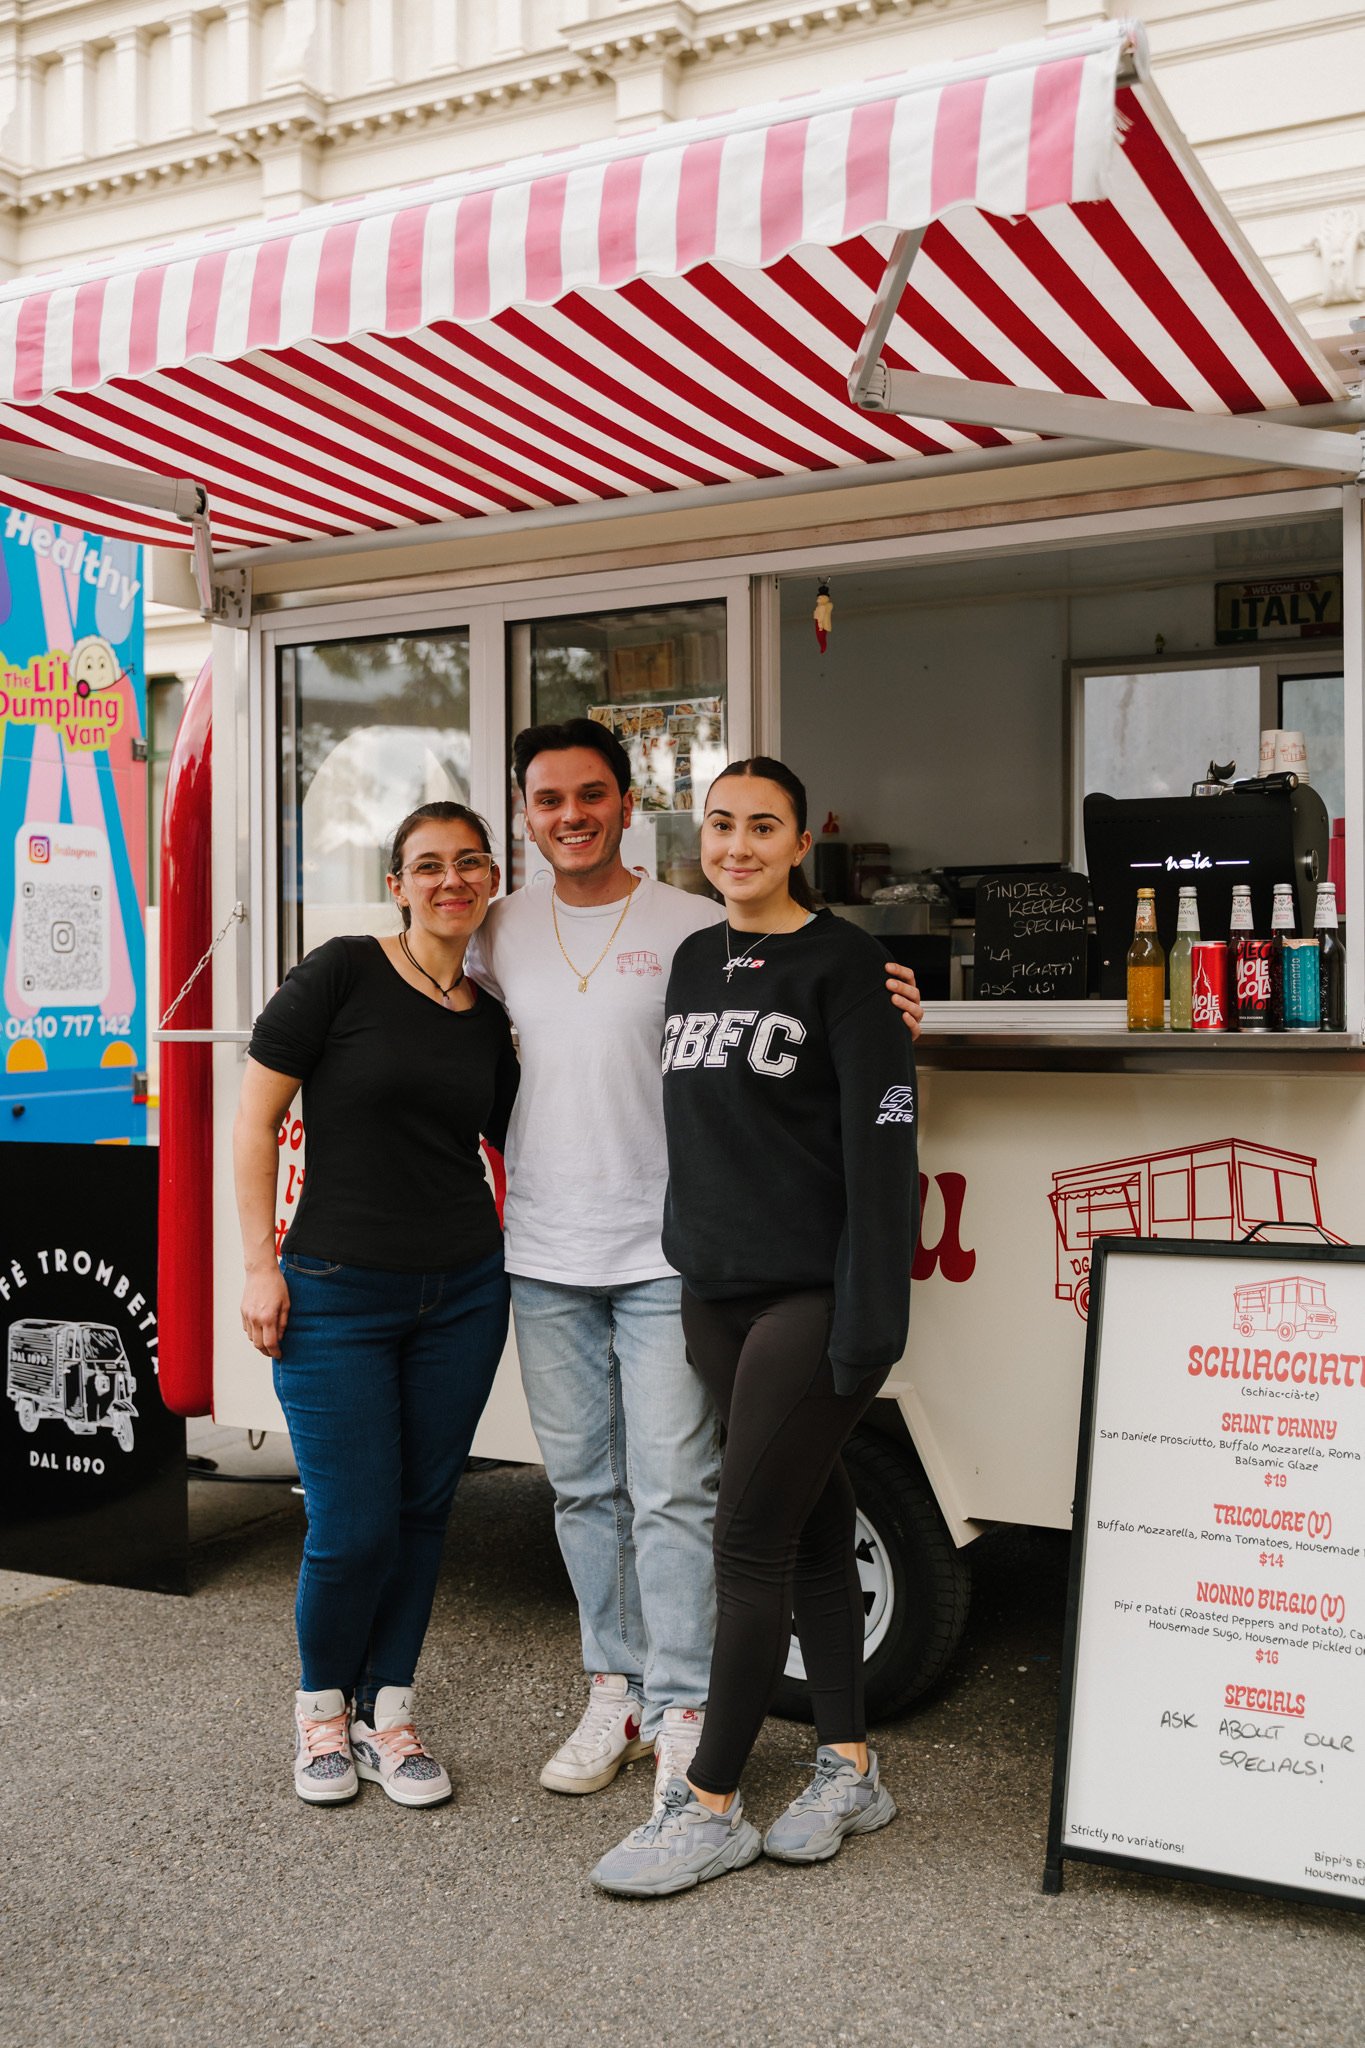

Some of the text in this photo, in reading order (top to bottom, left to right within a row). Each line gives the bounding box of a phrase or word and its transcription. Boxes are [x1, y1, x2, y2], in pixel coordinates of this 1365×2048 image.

[5, 508, 141, 611] Healthy
[1251, 582, 1312, 595] WELCOME TO
[1231, 590, 1333, 630] ITALY
[4, 672, 31, 688] The
[0, 690, 118, 727] Dumpling
[66, 724, 105, 746] Van
[1165, 851, 1212, 871] nota
[1008, 897, 1083, 918] KEEPERS
[981, 981, 1016, 996] ASK
[1238, 979, 1271, 999] COLA
[5, 1014, 131, 1040] 0410 717 142
[1194, 1009, 1223, 1026] COLA
[661, 1010, 807, 1079] GBFC
[1221, 1412, 1338, 1440] SAINT DANNY
[1100, 1429, 1361, 1461] San Daniele Prosciutto, Buffalo Mozzarella, Roma
[30, 1450, 105, 1475] DAL 1890
[1235, 1456, 1319, 1472] Balsamic Glaze
[1264, 1472, 1287, 1488] $19
[1213, 1503, 1306, 1532] TRICOLORE
[1097, 1519, 1360, 1557] Buffalo Mozzarella, Roma Tomatoes, Housemade
[1259, 1552, 1284, 1568] $14
[1196, 1581, 1255, 1608] NONNO
[1258, 1588, 1317, 1615] BIAGIO
[1114, 1600, 1365, 1640] Pipi e Patati (Roasted Peppers and Potato), Ca
[1148, 1619, 1365, 1656] Housemade Sugo, Housemade Pickled O
[1255, 1648, 1279, 1664] $16
[1223, 1683, 1306, 1715] SPECIALS
[1160, 1710, 1355, 1753] ASK ABOUT OUR
[1218, 1750, 1325, 1784] SPECIALS!
[1071, 1824, 1185, 1854] Strictly no variations!
[1314, 1851, 1353, 1868] Bippi's
